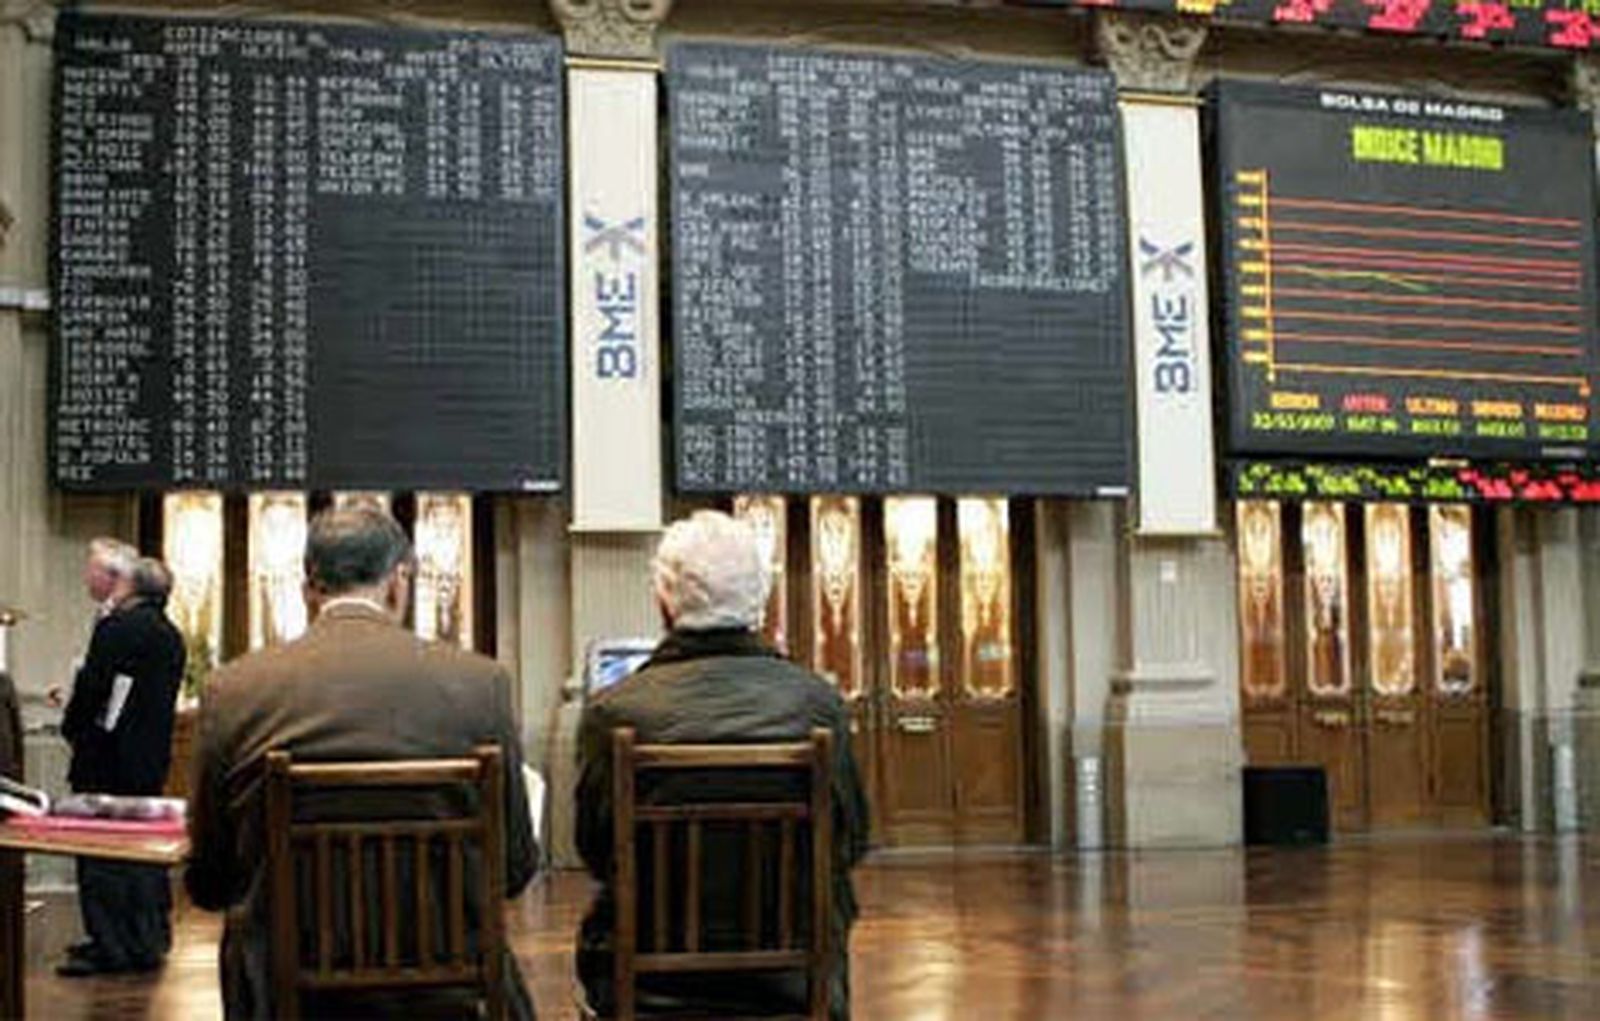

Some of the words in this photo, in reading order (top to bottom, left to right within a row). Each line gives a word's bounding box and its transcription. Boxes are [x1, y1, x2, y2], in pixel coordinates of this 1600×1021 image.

[1320, 91, 1390, 112] BOLSA
[1392, 99, 1419, 115] DE
[1425, 102, 1504, 121] MADRID
[1422, 130, 1503, 170] MADRID
[596, 271, 638, 379] BME
[1152, 293, 1190, 394] BME
